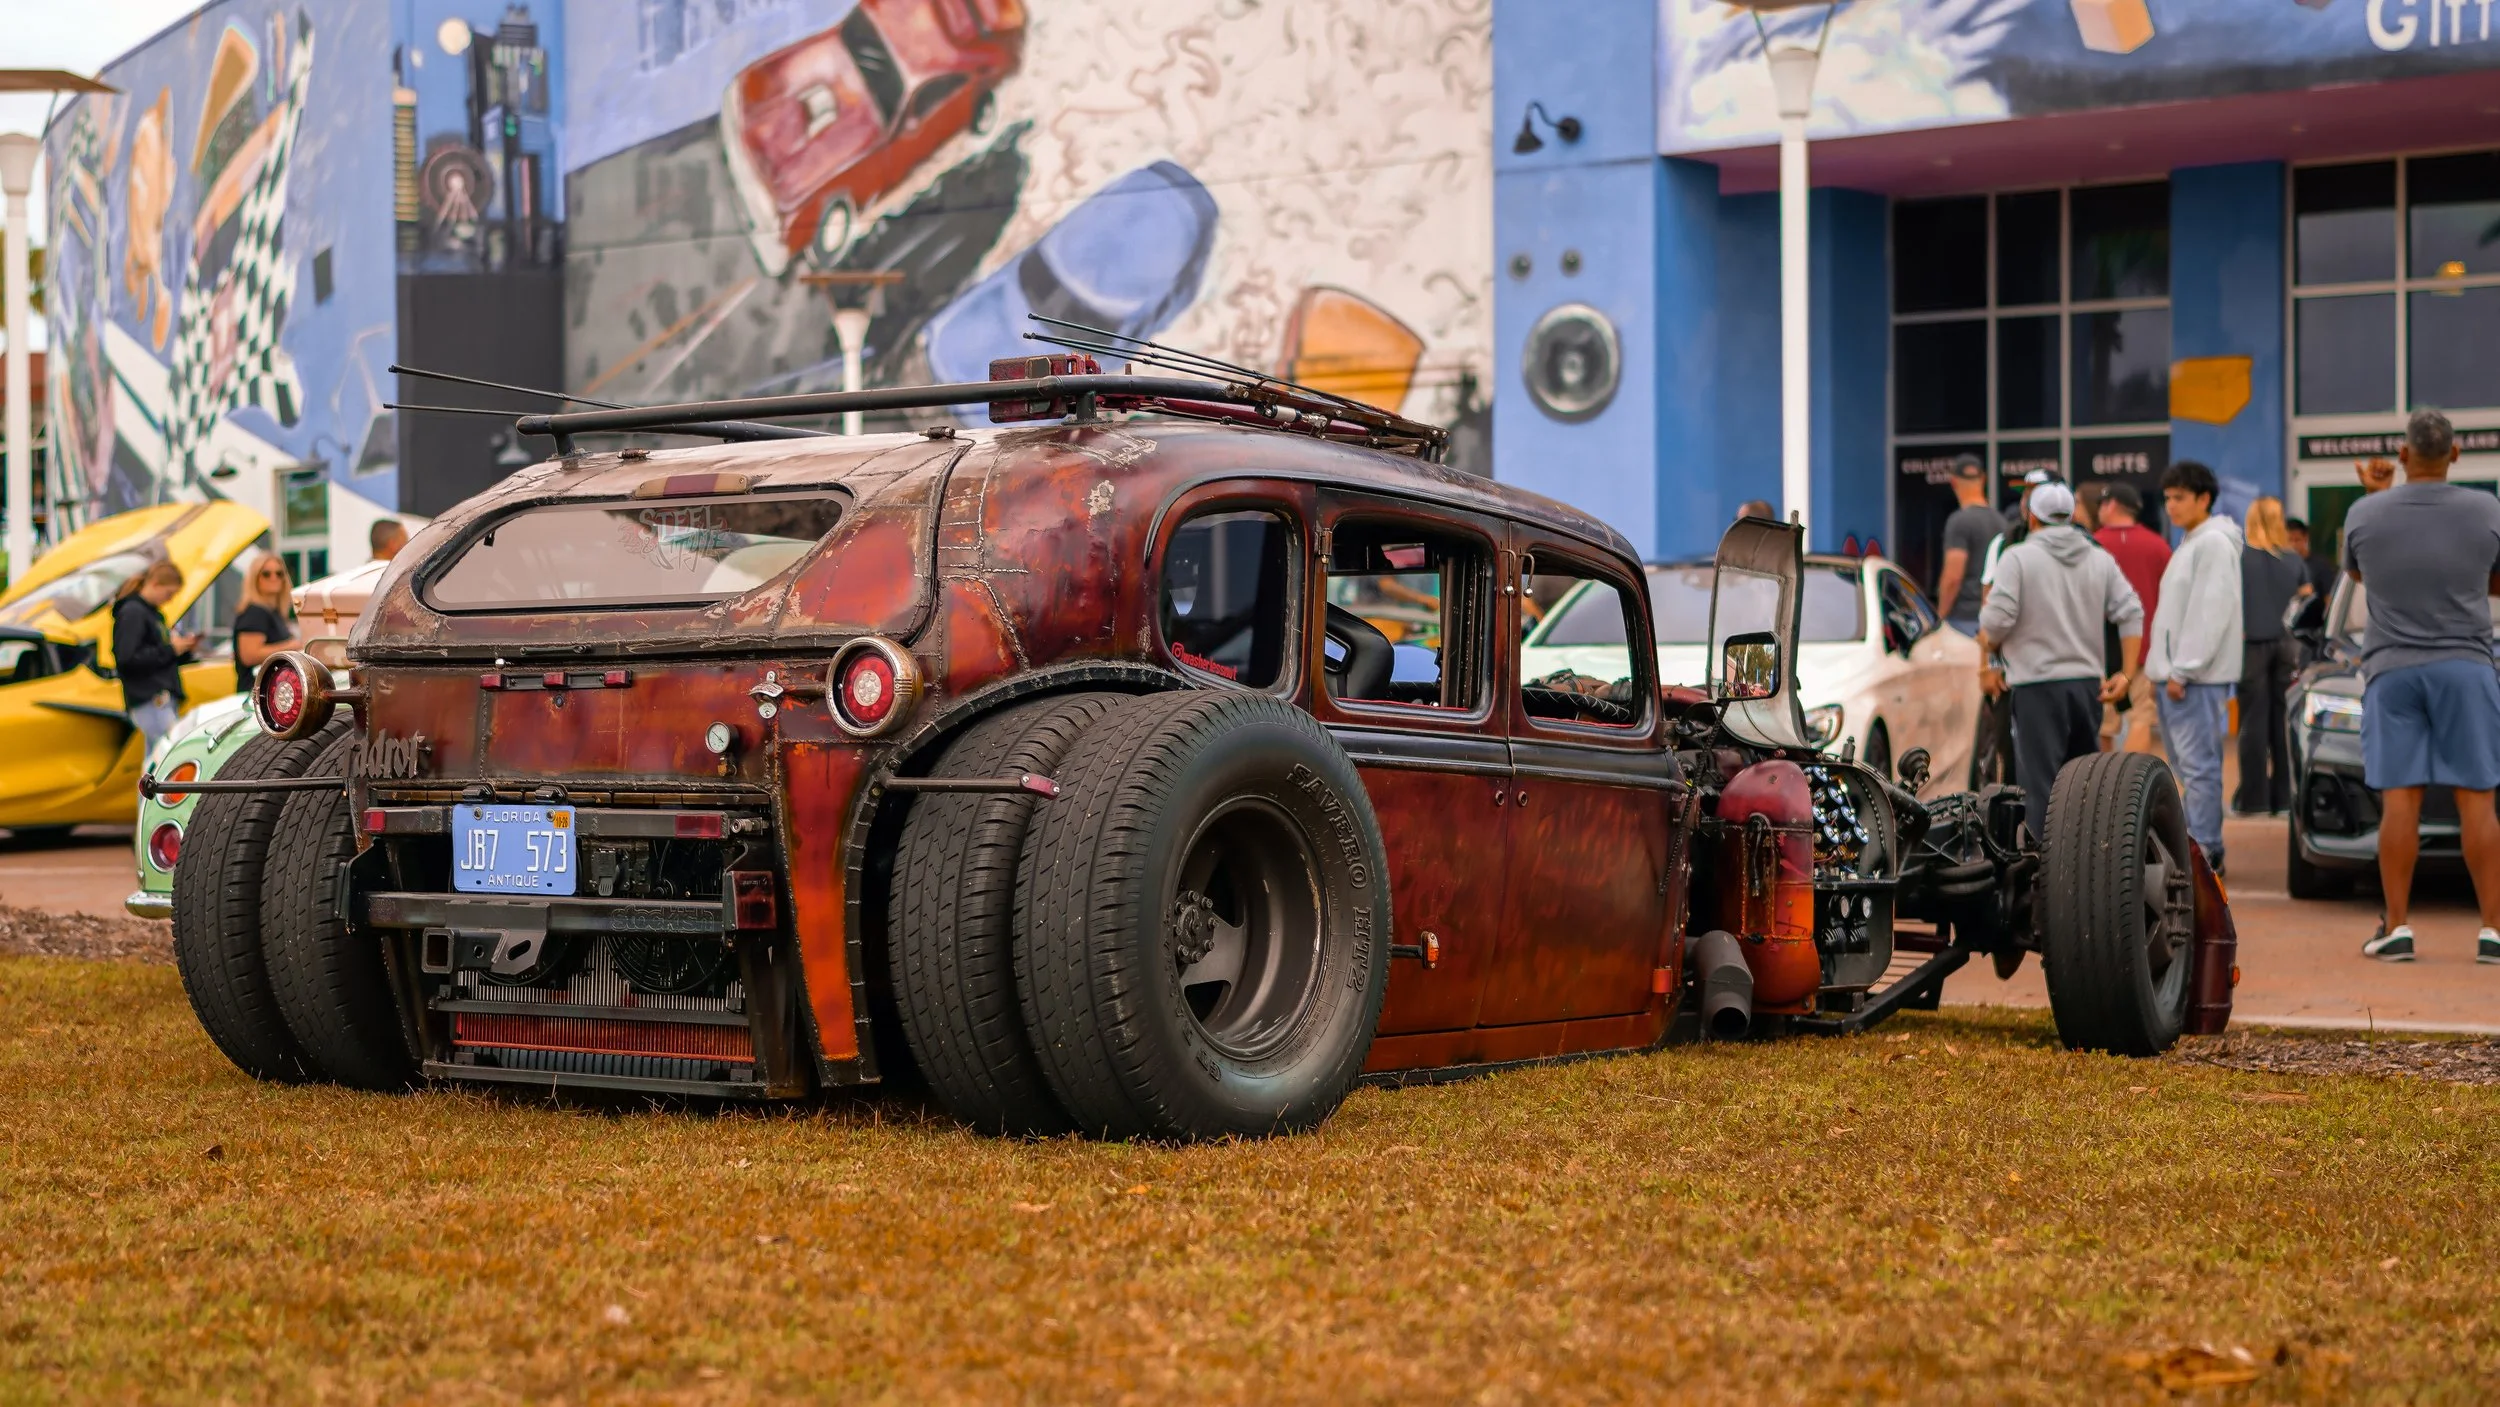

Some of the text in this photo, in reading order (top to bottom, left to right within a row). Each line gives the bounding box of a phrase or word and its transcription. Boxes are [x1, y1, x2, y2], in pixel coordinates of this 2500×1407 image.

[2308, 437, 2382, 455] WELCOME
[2092, 453, 2149, 474] GIFTS
[485, 810, 541, 823] FLORIDA
[460, 829, 567, 873] JB7 573
[487, 874, 539, 887] ANTIQUE
[1287, 763, 1368, 889] SAVERO
[1347, 906, 1372, 993] HT2
